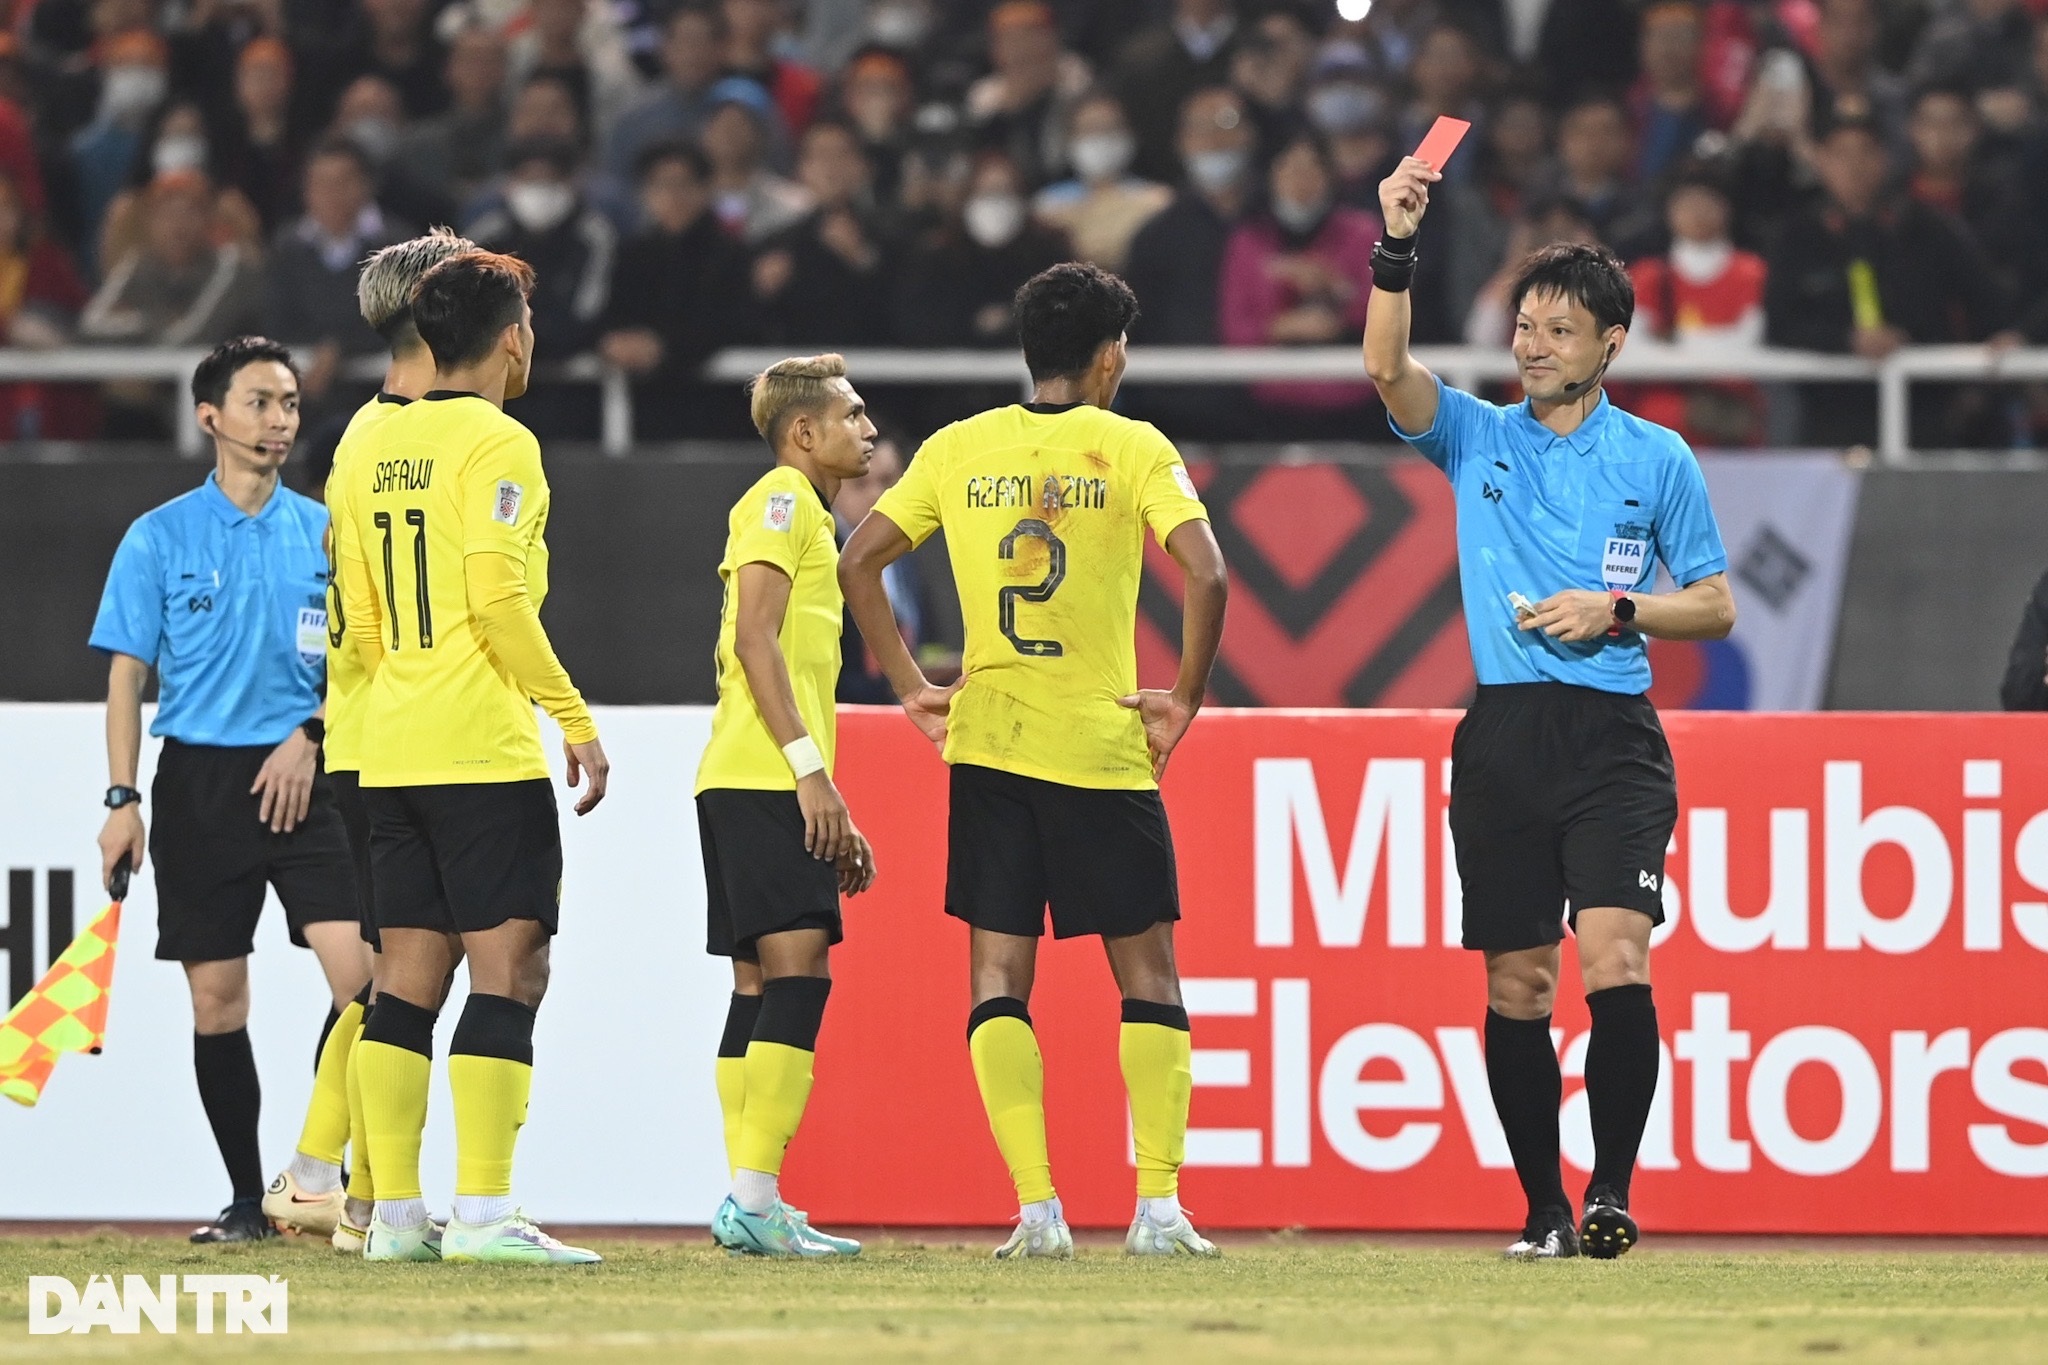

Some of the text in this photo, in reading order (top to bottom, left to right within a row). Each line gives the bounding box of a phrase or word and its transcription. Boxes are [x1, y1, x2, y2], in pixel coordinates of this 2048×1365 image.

[372, 458, 434, 493] SAFAWI
[967, 475, 1106, 509] AZAM AZMI
[1609, 541, 1640, 557] FIFA
[373, 508, 434, 651] 11
[1605, 564, 1638, 574] REFEREE
[998, 518, 1066, 657] 2
